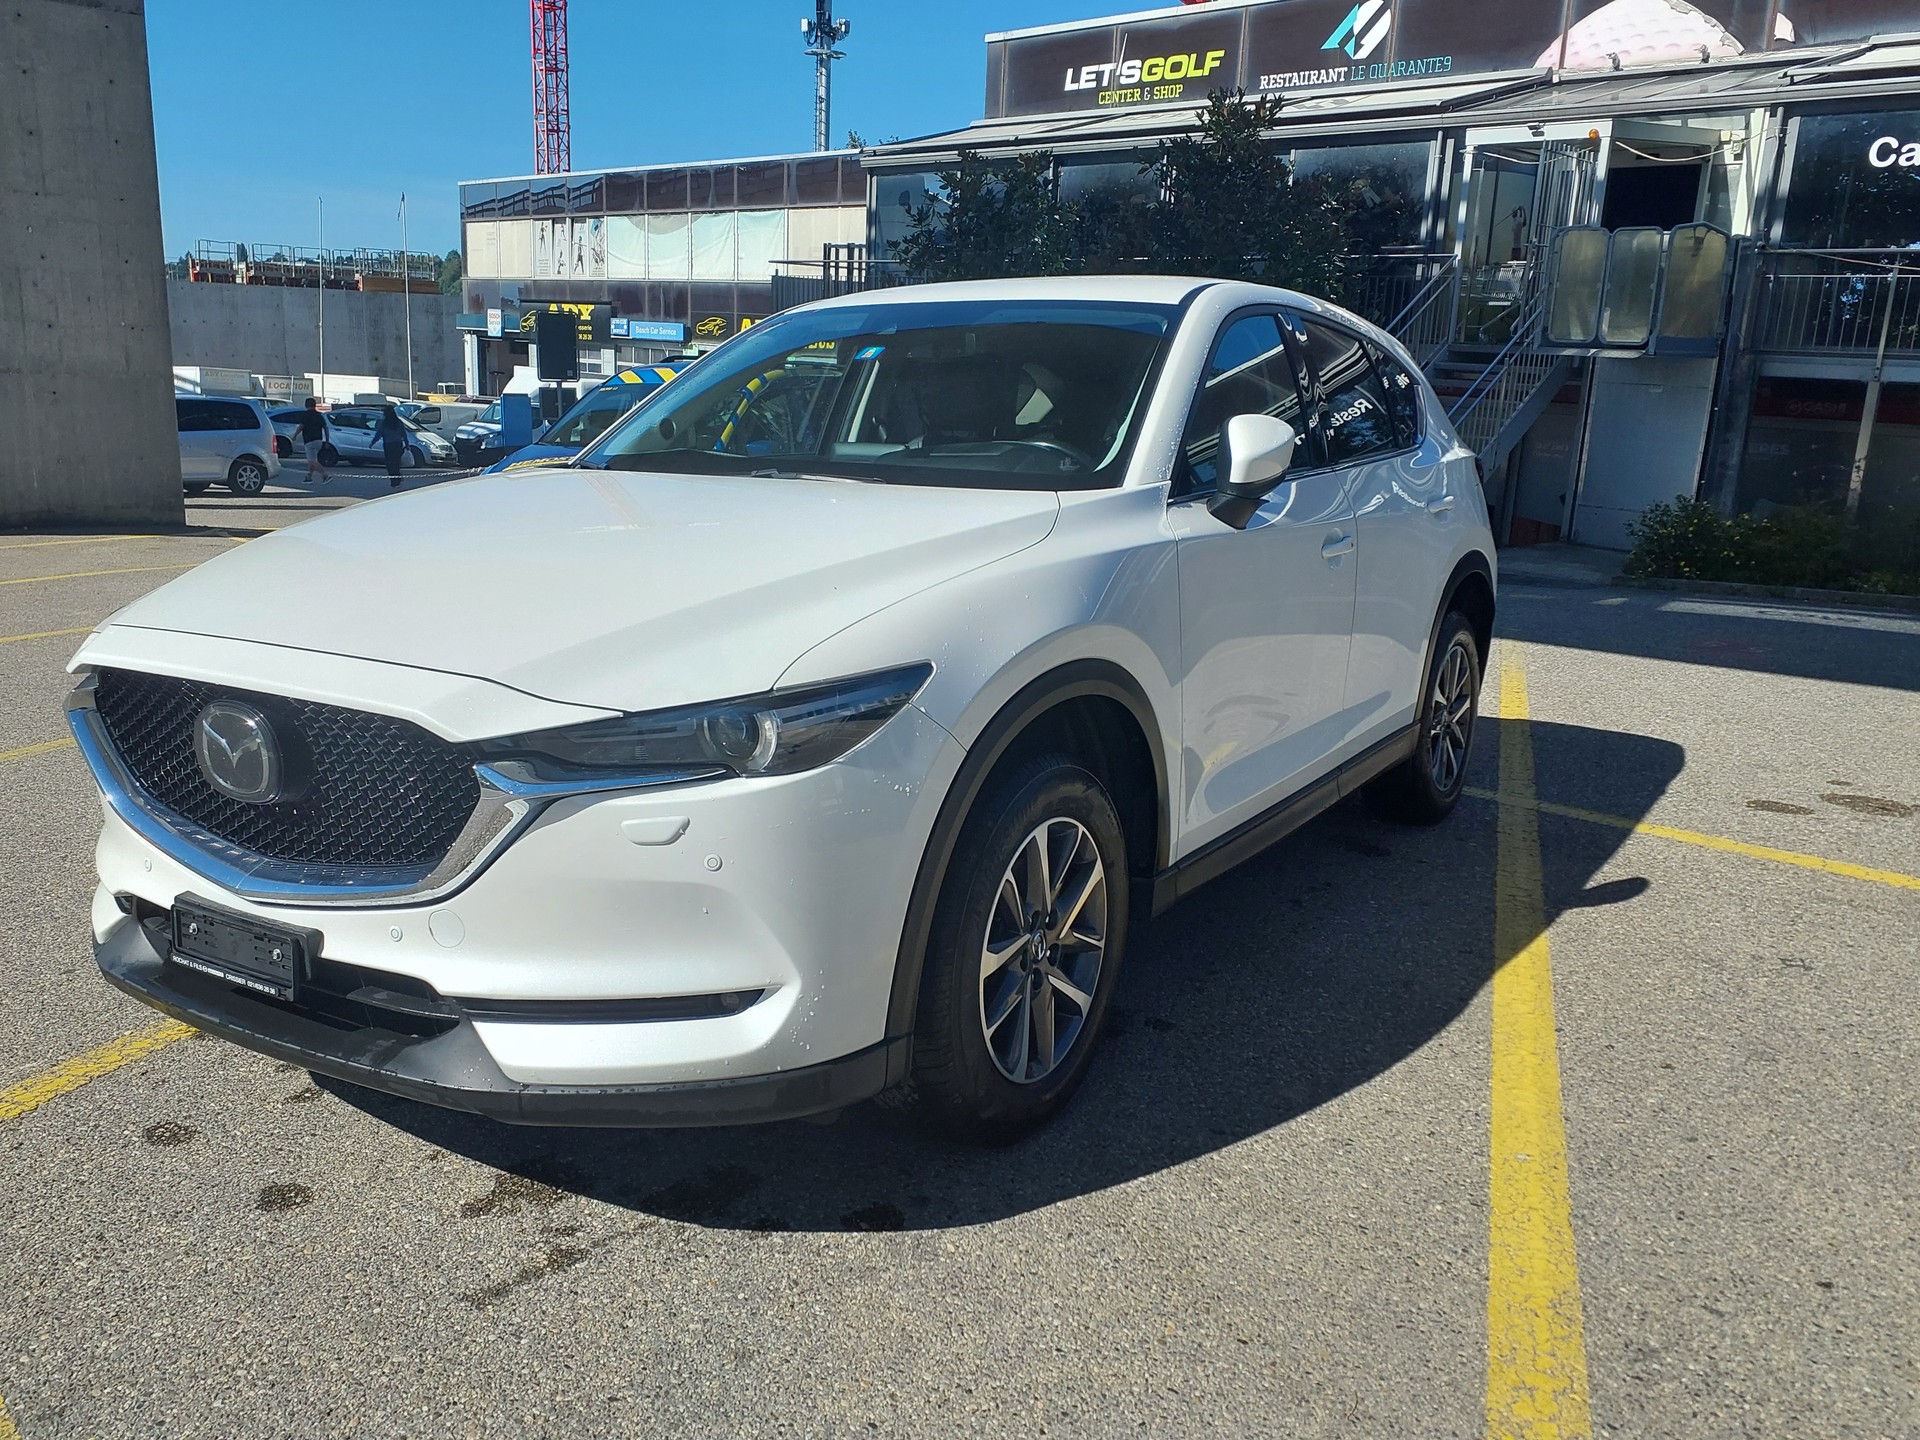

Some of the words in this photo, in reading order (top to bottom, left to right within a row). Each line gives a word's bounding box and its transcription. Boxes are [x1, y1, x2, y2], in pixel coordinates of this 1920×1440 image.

[1259, 67, 1349, 90] RESTAURANT
[1350, 65, 1367, 82] LE
[1369, 56, 1453, 81] QUARANTE9
[1099, 88, 1142, 105] CENTER
[1144, 87, 1151, 101] &
[1153, 83, 1184, 100] SHOP
[1868, 136, 1920, 168] Ca
[635, 325, 650, 334] Bosch
[650, 326, 659, 335] Car
[659, 327, 678, 336] Service
